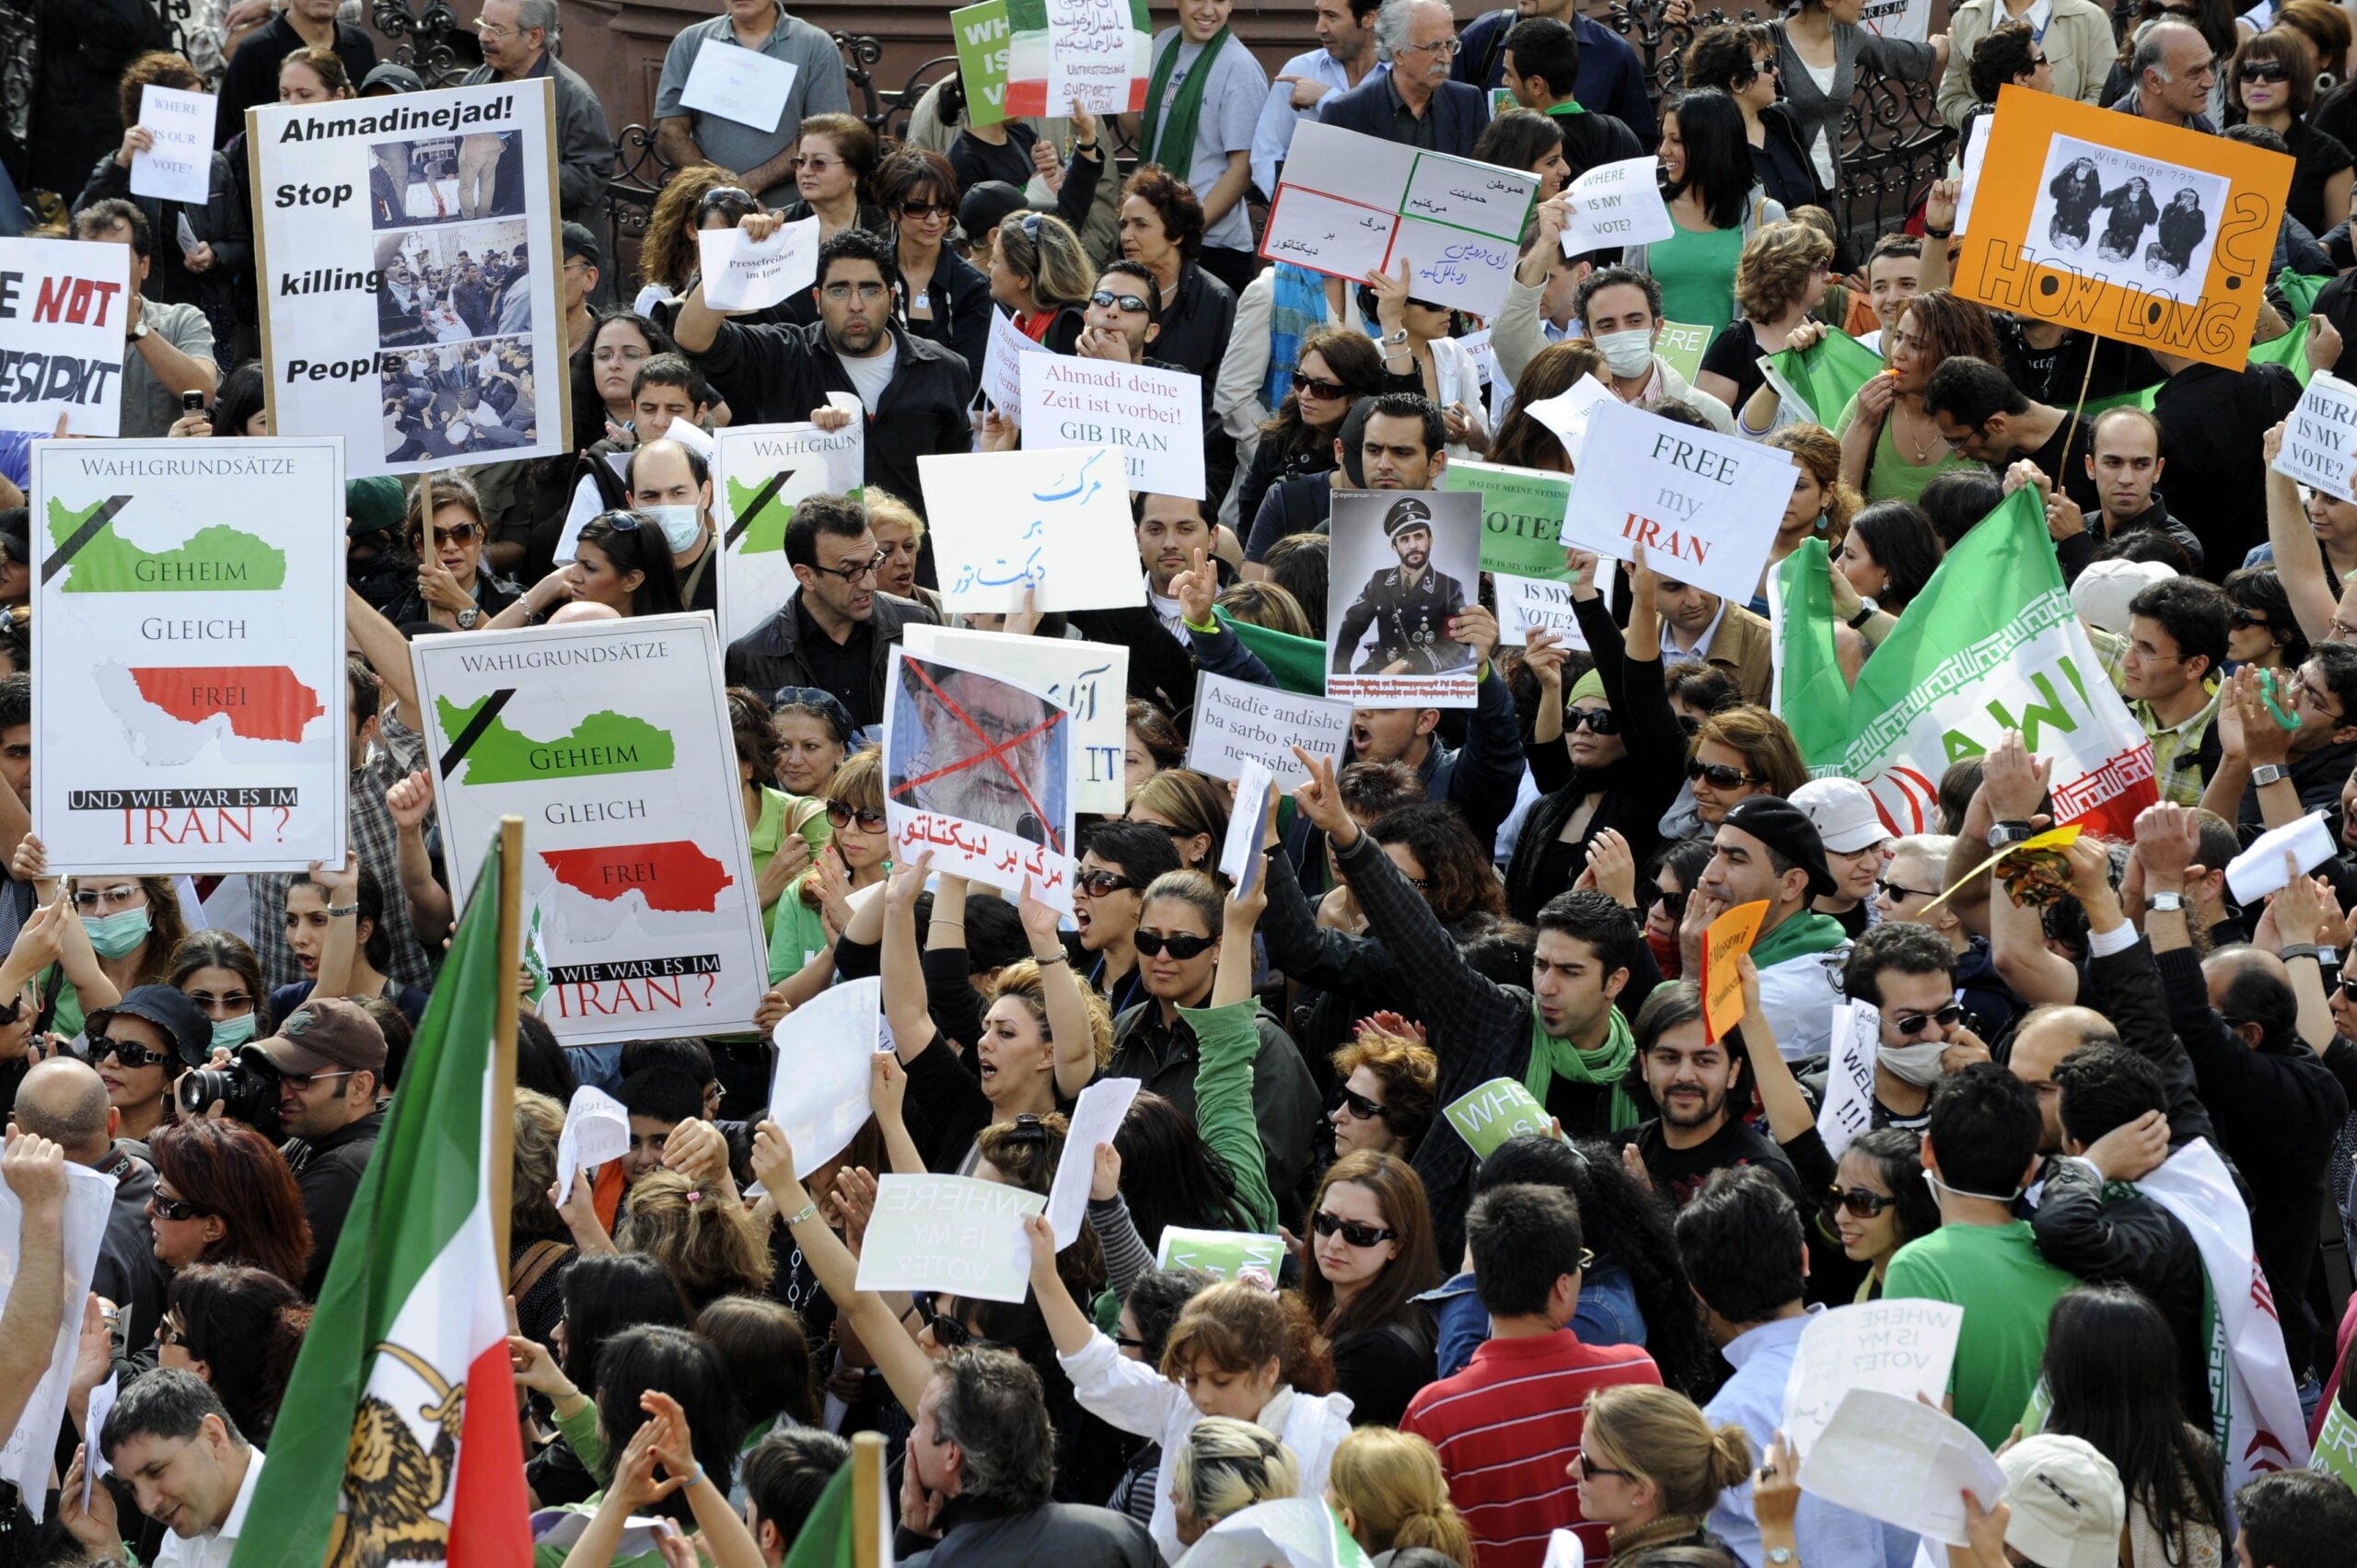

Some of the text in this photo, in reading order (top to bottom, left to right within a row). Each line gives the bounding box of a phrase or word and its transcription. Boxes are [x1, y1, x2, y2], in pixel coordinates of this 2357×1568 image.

[155, 99, 199, 115] WHERE
[279, 95, 514, 144] Ahmadinejad!
[168, 132, 196, 145] OUR
[152, 158, 192, 174] VOTE?
[2093, 148, 2119, 167] Wie
[2124, 159, 2164, 178] lange
[1583, 168, 1626, 188] WHERE
[275, 182, 352, 208] Stop
[1587, 194, 1622, 211] IS MY
[1593, 218, 1631, 236] VOTE?
[729, 250, 795, 268] Pressefreiheit
[762, 266, 782, 279] Iran
[280, 268, 386, 297] killing
[1979, 238, 2241, 355] HOW LONG
[32, 275, 122, 327] NOT
[285, 351, 402, 384] People
[1045, 365, 1178, 399] Ahmadi deine
[1042, 389, 1082, 411] Zeit
[1088, 393, 1111, 413] ist
[1116, 403, 1182, 425] vorbei!
[2301, 391, 2357, 429] HERE
[1060, 421, 1167, 453] GIB IRAN
[2297, 416, 2346, 451] IS MY
[1649, 432, 1739, 486] FREE
[2292, 442, 2344, 481] VOTE?
[1502, 483, 1532, 497] MEINE
[1655, 486, 1704, 523] my
[1482, 509, 1563, 541] OTE?
[1620, 512, 1713, 567] IRAN
[1524, 583, 1572, 606] IS MY
[1518, 607, 1573, 630] VOTE?
[191, 686, 247, 708] FREI
[1207, 686, 1344, 730] Asadie andishe
[1204, 708, 1336, 754] ba sarbo shatm
[127, 789, 172, 808] WIE
[181, 789, 234, 807] WAR
[238, 788, 261, 807] ES
[271, 787, 298, 806] IM
[601, 862, 657, 885] FREI
[560, 963, 601, 982] WIE
[607, 958, 655, 980] WAR
[662, 958, 685, 976] ES
[692, 954, 721, 973] IM
